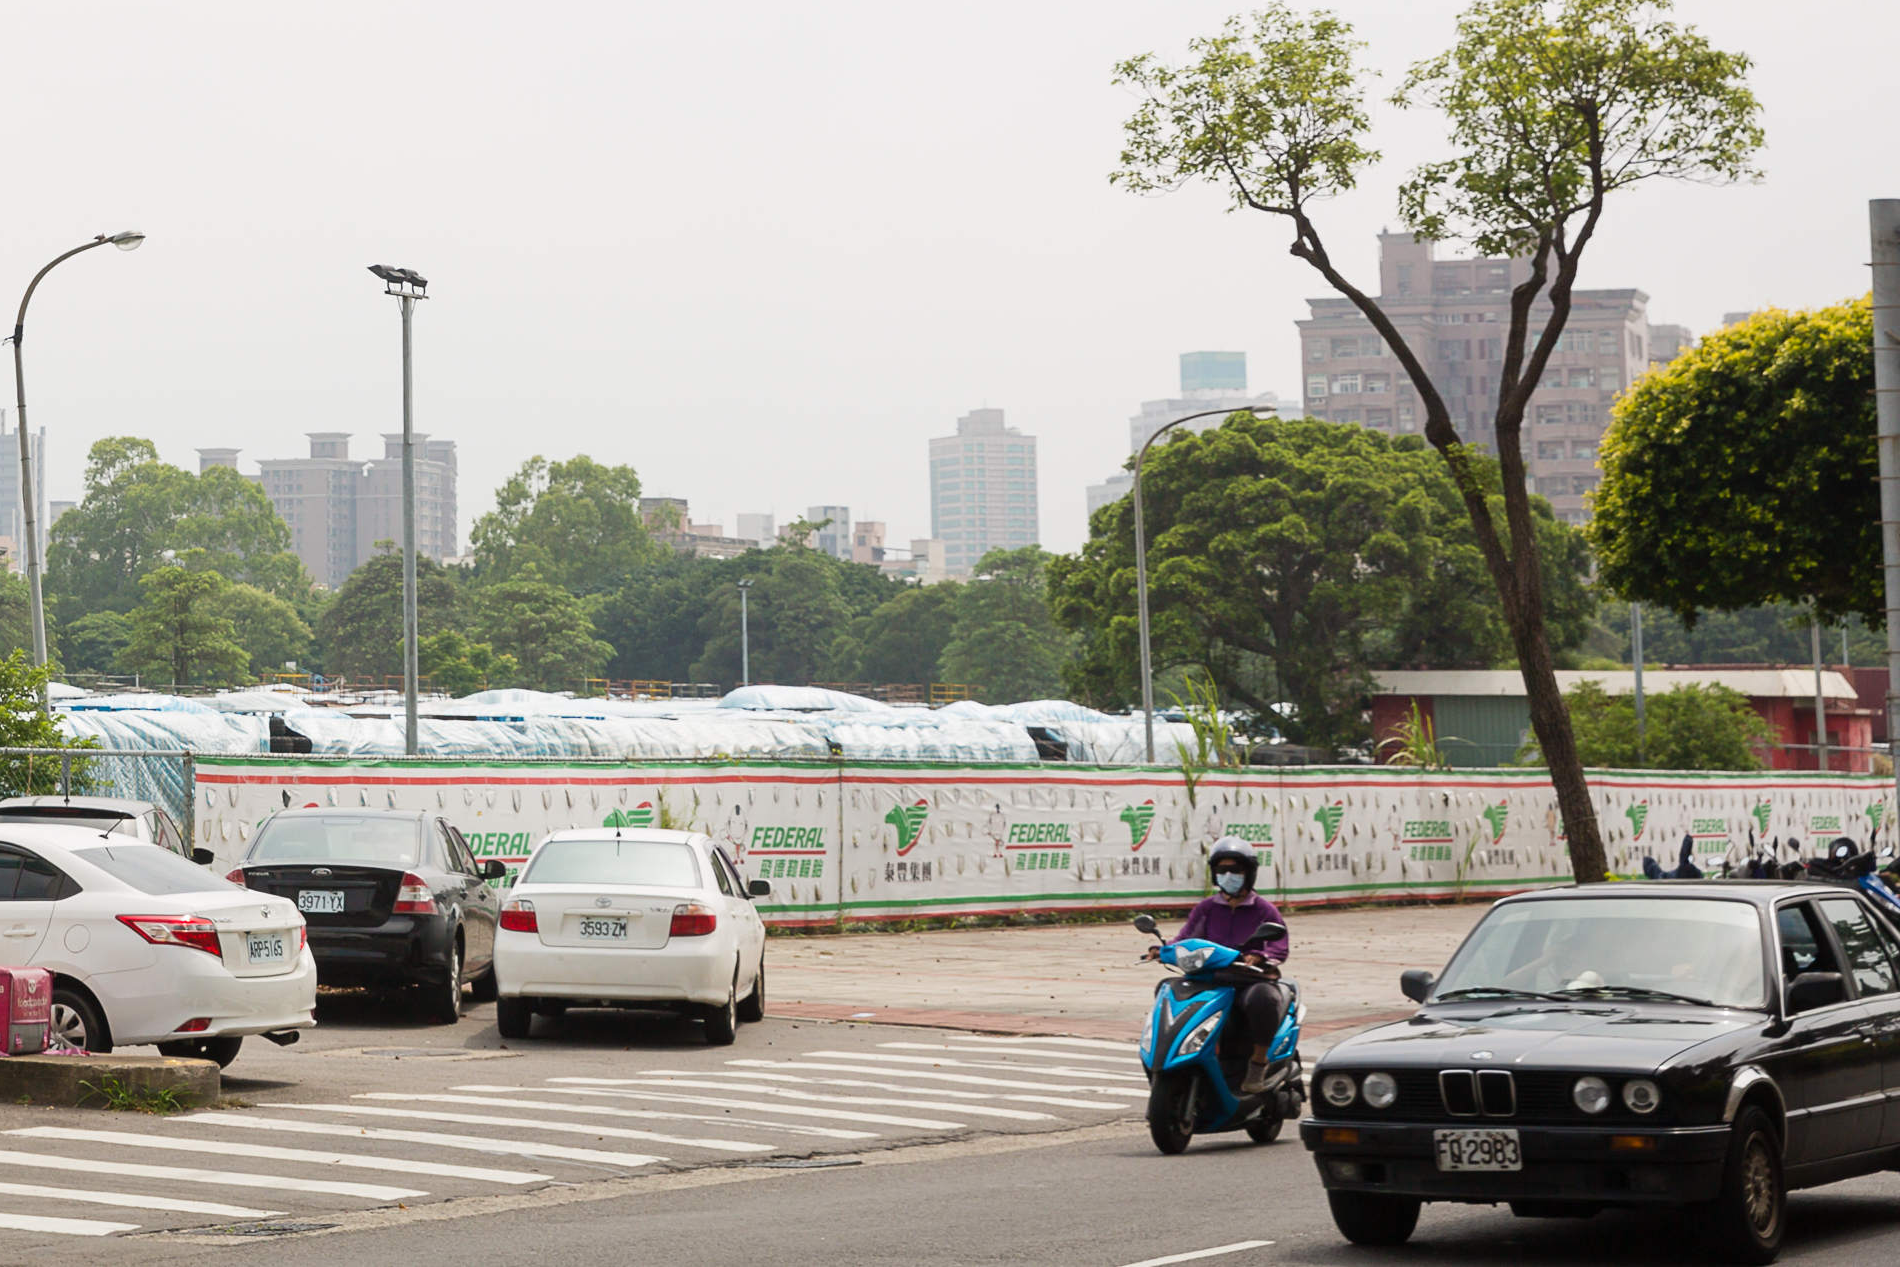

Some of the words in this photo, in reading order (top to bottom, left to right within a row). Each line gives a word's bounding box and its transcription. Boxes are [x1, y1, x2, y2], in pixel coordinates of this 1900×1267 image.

[750, 826, 824, 848] FEDERAL
[1008, 823, 1071, 843] FEDERAL
[1225, 823, 1272, 841] FEDERAL
[1403, 821, 1451, 837] FEDERAL
[250, 939, 283, 958] ARP-5165
[1436, 1139, 1519, 1165] FQ-2983
